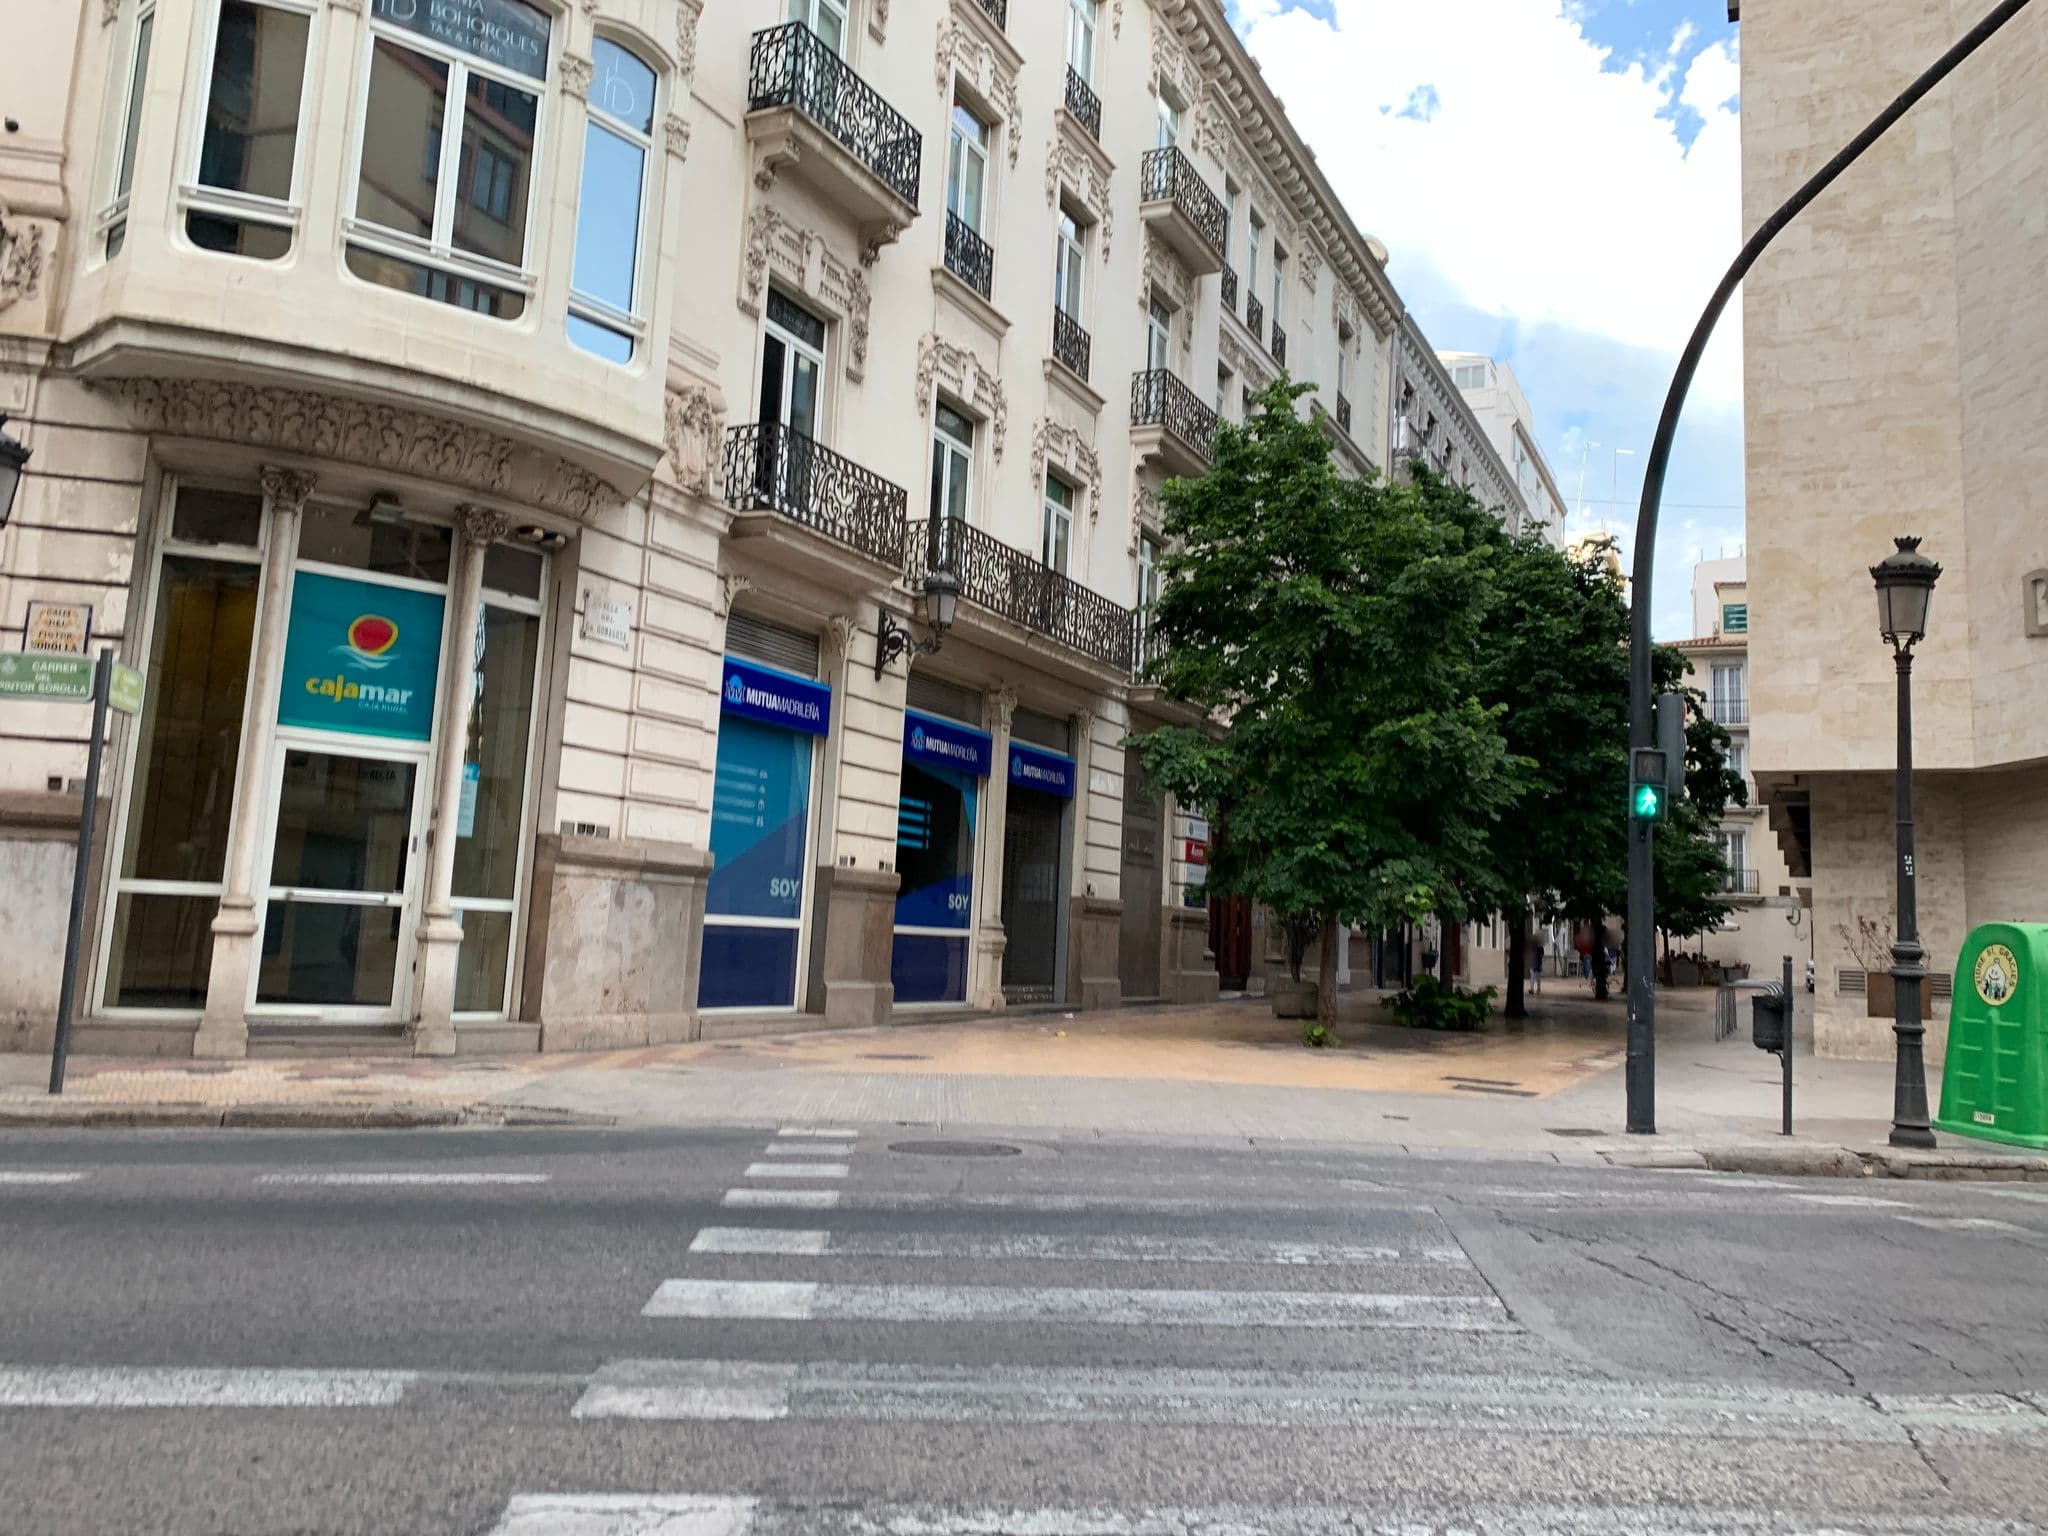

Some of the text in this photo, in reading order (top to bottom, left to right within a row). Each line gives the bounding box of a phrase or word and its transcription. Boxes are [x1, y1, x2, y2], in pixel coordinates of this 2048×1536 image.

[430, 0, 538, 56] BOHORQUES
[431, 22, 502, 57] TAX & LEGAL
[31, 661, 78, 673] CARRER
[35, 673, 51, 681] DEL
[38, 682, 87, 695] SOROLLA
[305, 674, 413, 705] cajamar
[358, 701, 409, 715] CAJA RURAL
[745, 686, 820, 721] MUTUAMADRILEÑA
[925, 735, 978, 763] MUTUAMADRILEÑA
[1023, 763, 1066, 786] MUTUAMADRILEÑA
[770, 877, 800, 898] SOY
[948, 892, 969, 910] SOY
